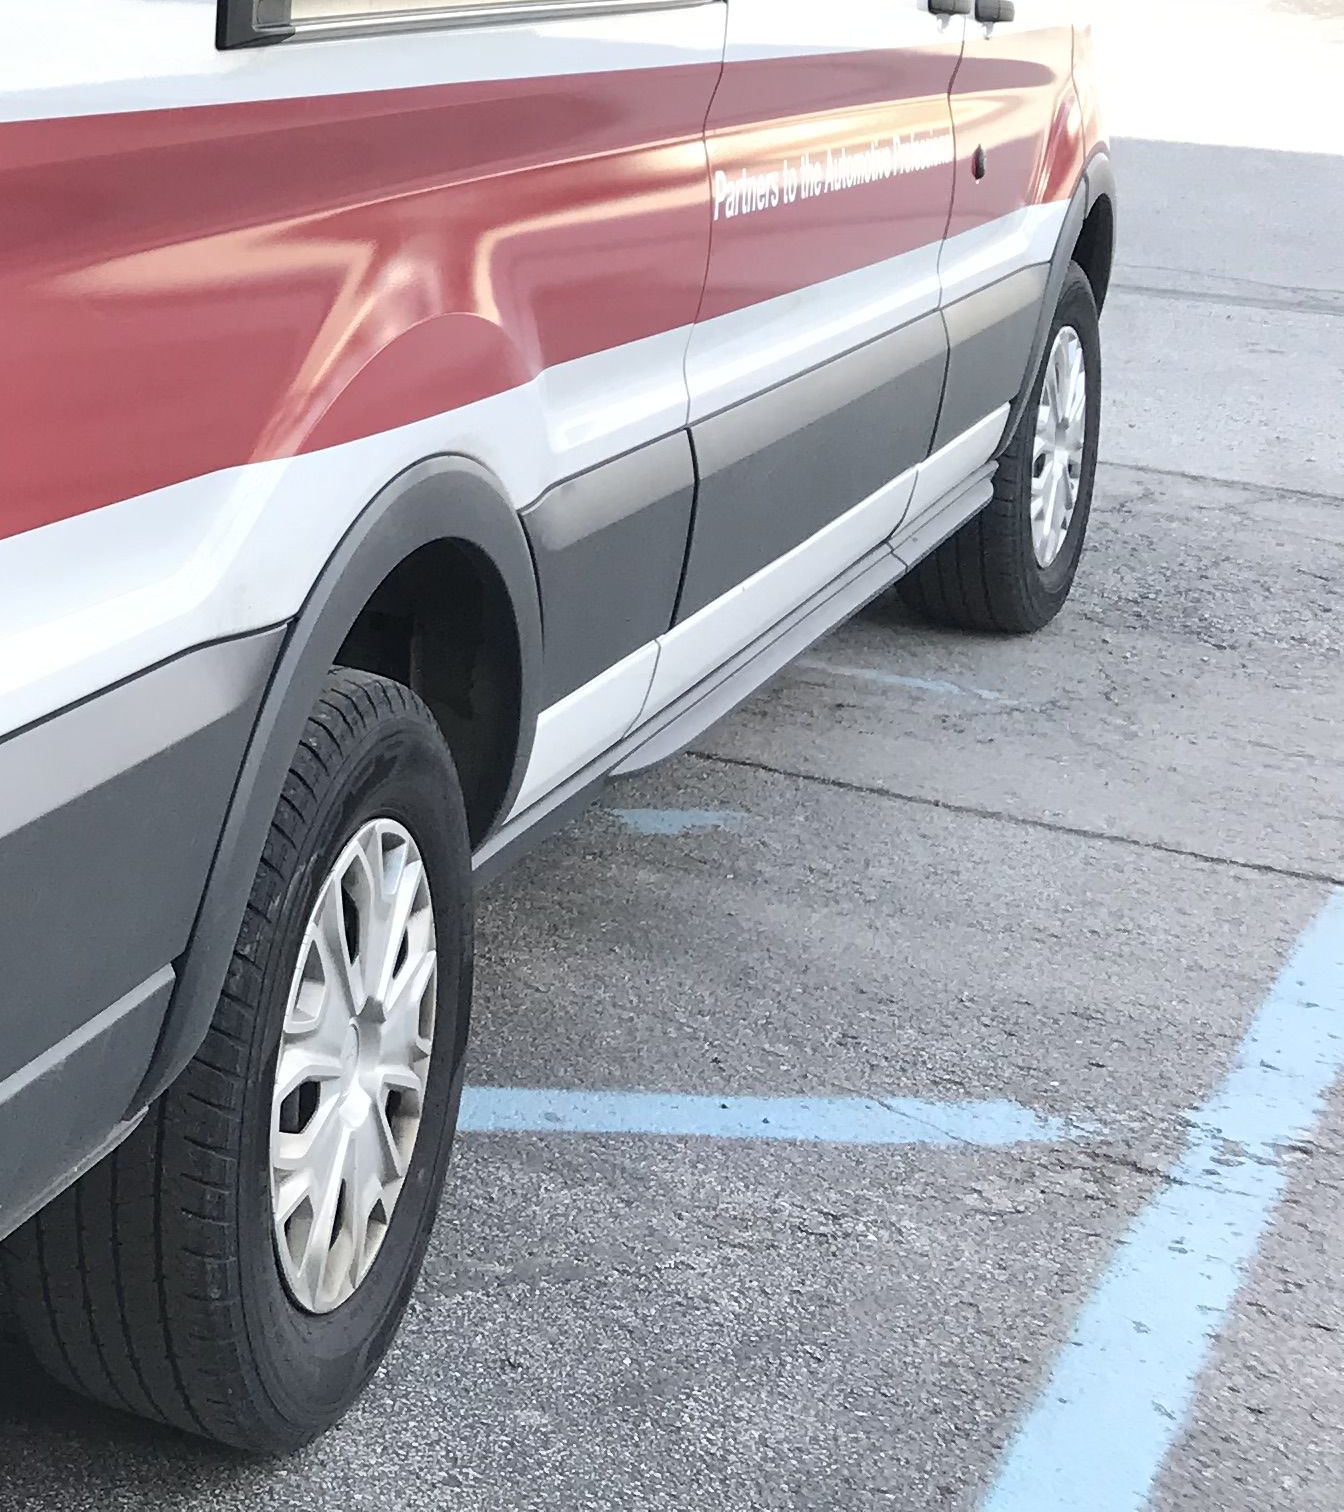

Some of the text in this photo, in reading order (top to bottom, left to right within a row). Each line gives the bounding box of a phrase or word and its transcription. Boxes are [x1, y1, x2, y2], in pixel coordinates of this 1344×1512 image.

[714, 168, 779, 221] Partners
[783, 159, 797, 204] to
[800, 152, 822, 200] the
